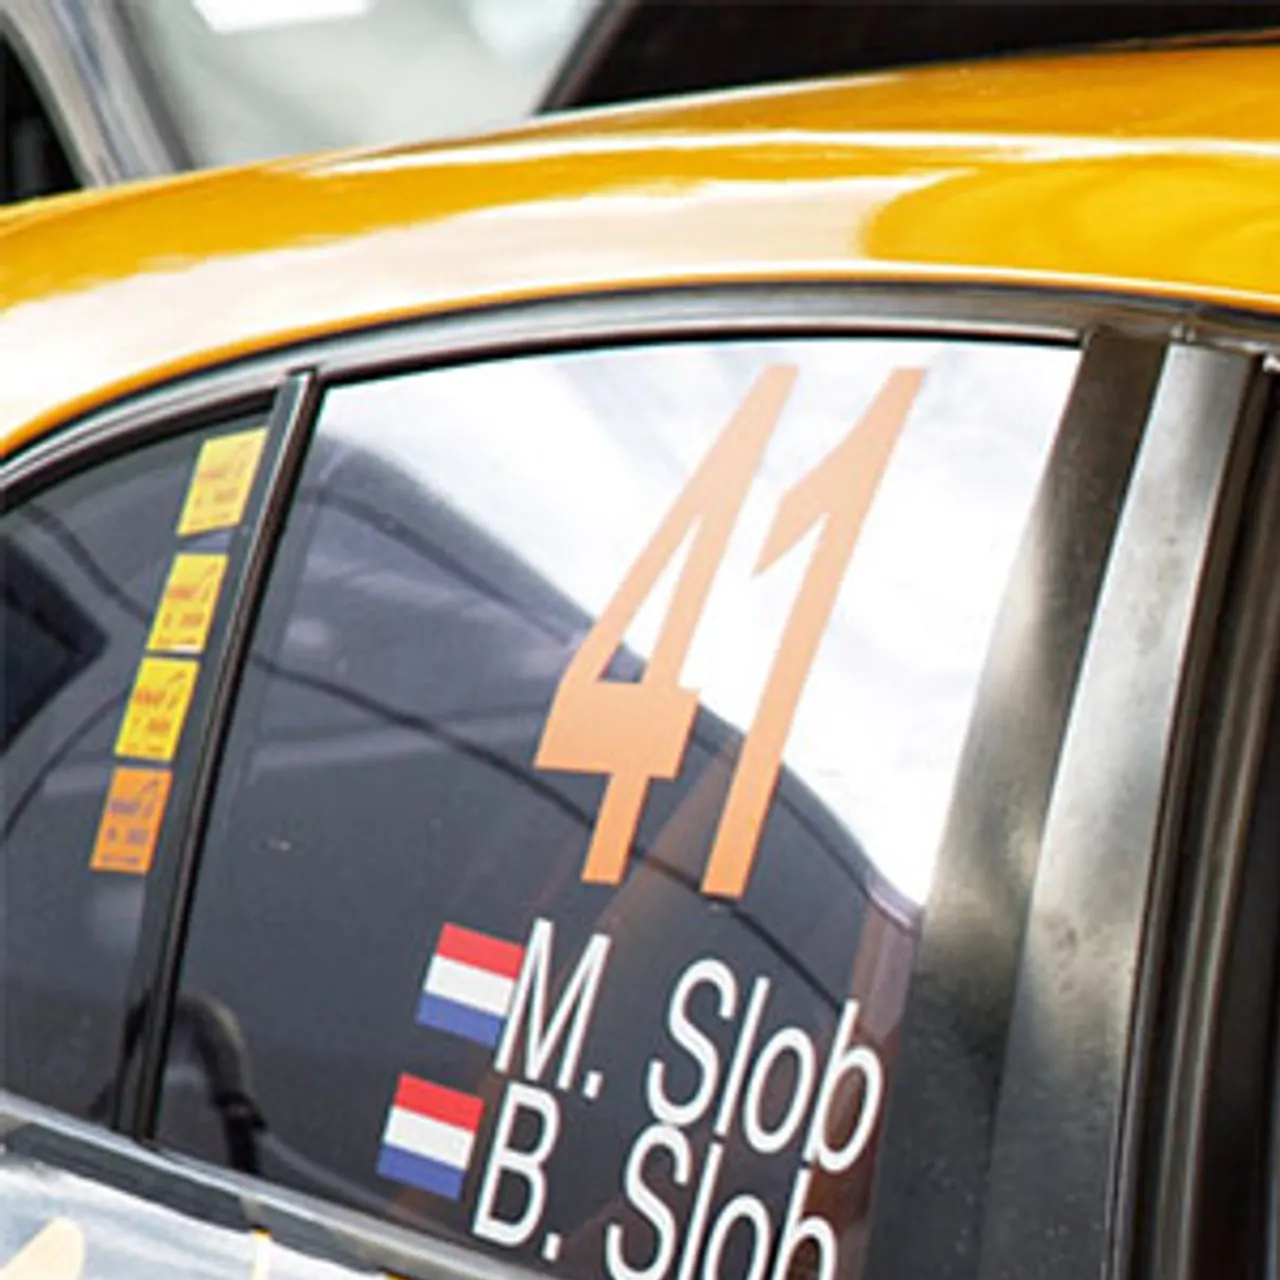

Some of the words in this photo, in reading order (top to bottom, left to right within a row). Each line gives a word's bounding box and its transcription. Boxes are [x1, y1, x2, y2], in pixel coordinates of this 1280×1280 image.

[535, 365, 928, 899] 41
[471, 1081, 561, 1261] B.
[494, 917, 612, 1100] M.
[647, 958, 883, 1172] Slob
